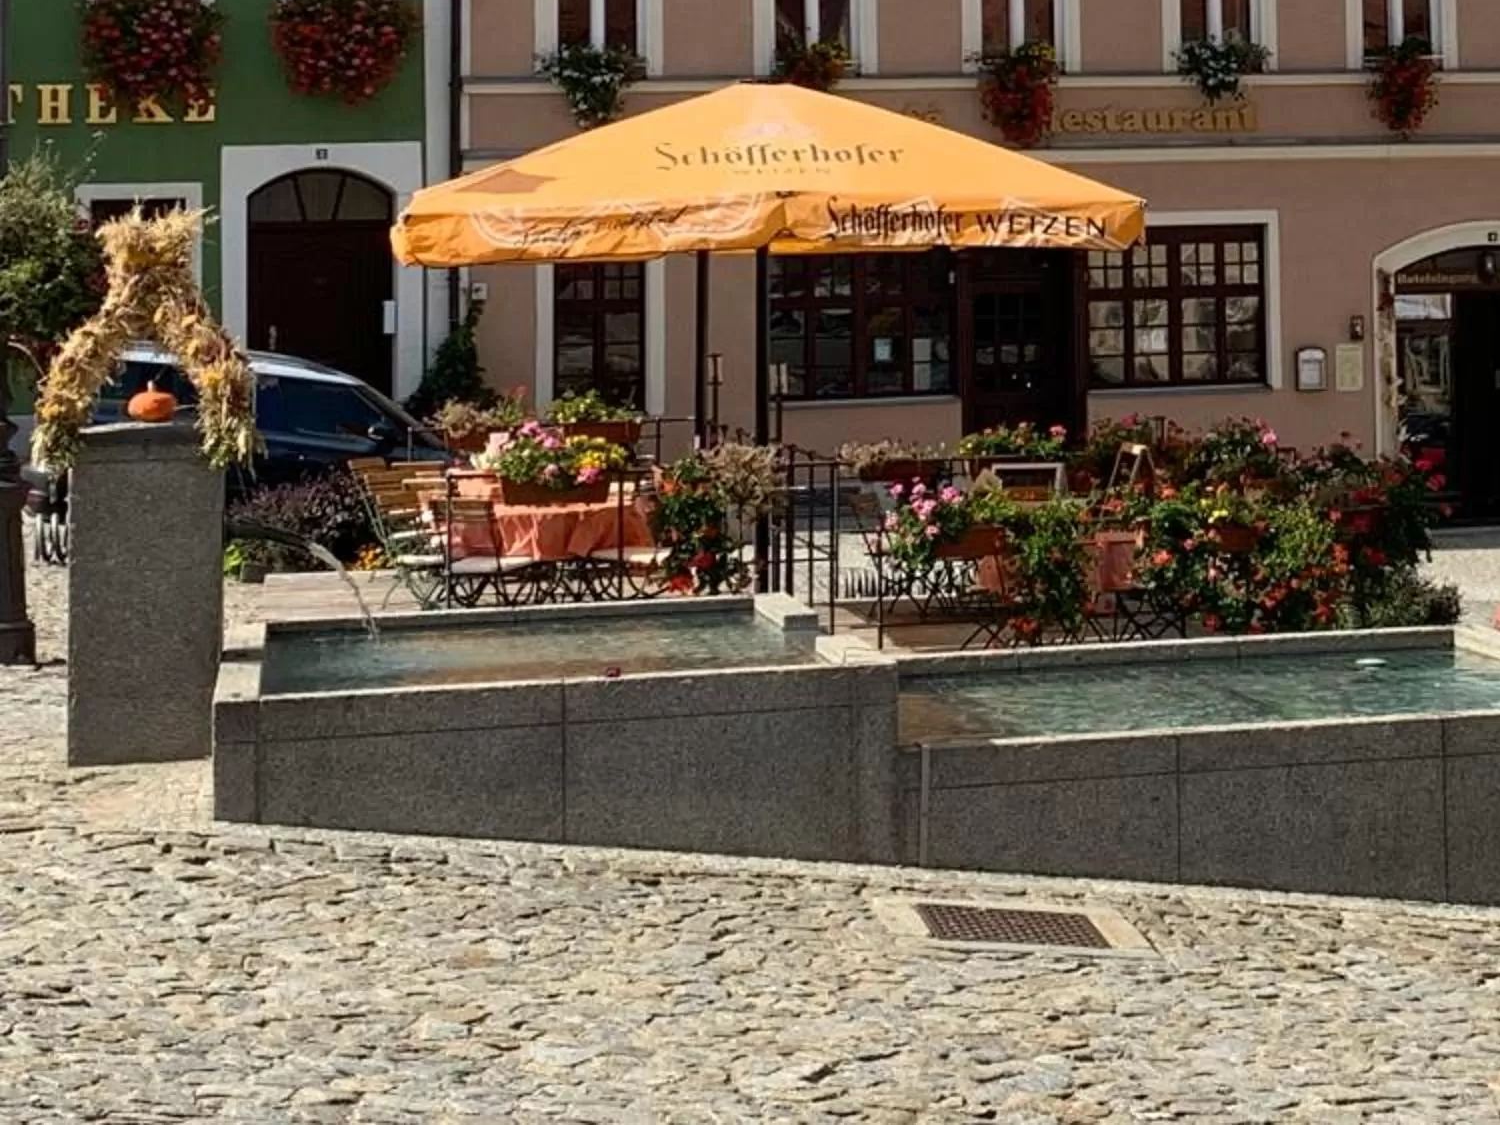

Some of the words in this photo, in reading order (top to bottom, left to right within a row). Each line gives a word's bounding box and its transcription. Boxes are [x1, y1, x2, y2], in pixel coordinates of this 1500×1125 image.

[655, 142, 905, 171] Schöfferhofer
[825, 195, 964, 241] Schöfferhofer
[976, 211, 1107, 239] WEIZEN
